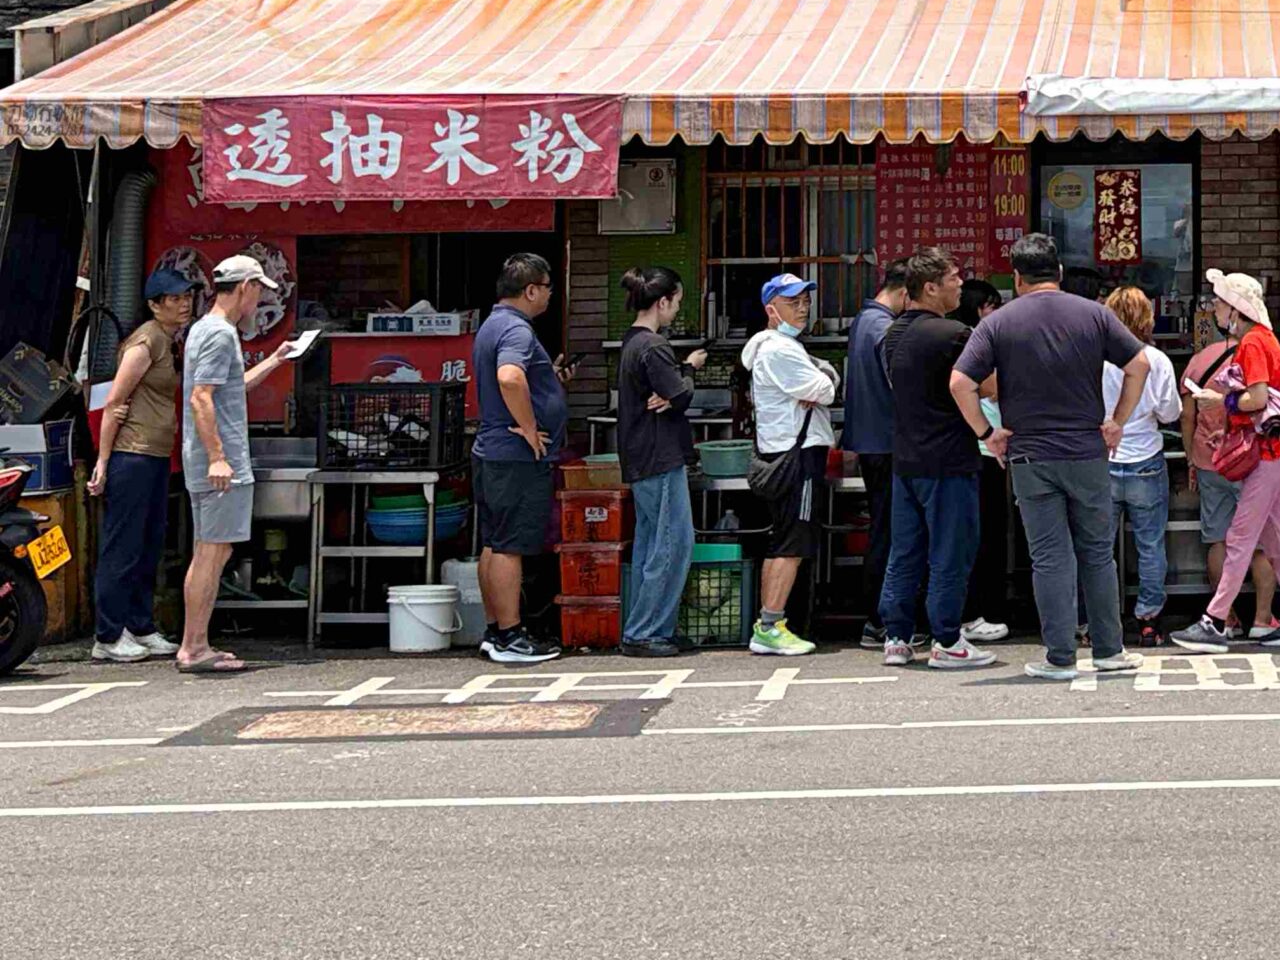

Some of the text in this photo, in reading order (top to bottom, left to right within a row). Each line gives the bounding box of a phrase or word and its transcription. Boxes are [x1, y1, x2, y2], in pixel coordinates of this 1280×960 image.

[223, 108, 603, 187] 透抽米粉
[994, 154, 1025, 176] 11:00
[994, 194, 1025, 217] 19:00
[1098, 190, 1117, 224] 發財
[440, 359, 471, 382] 脆
